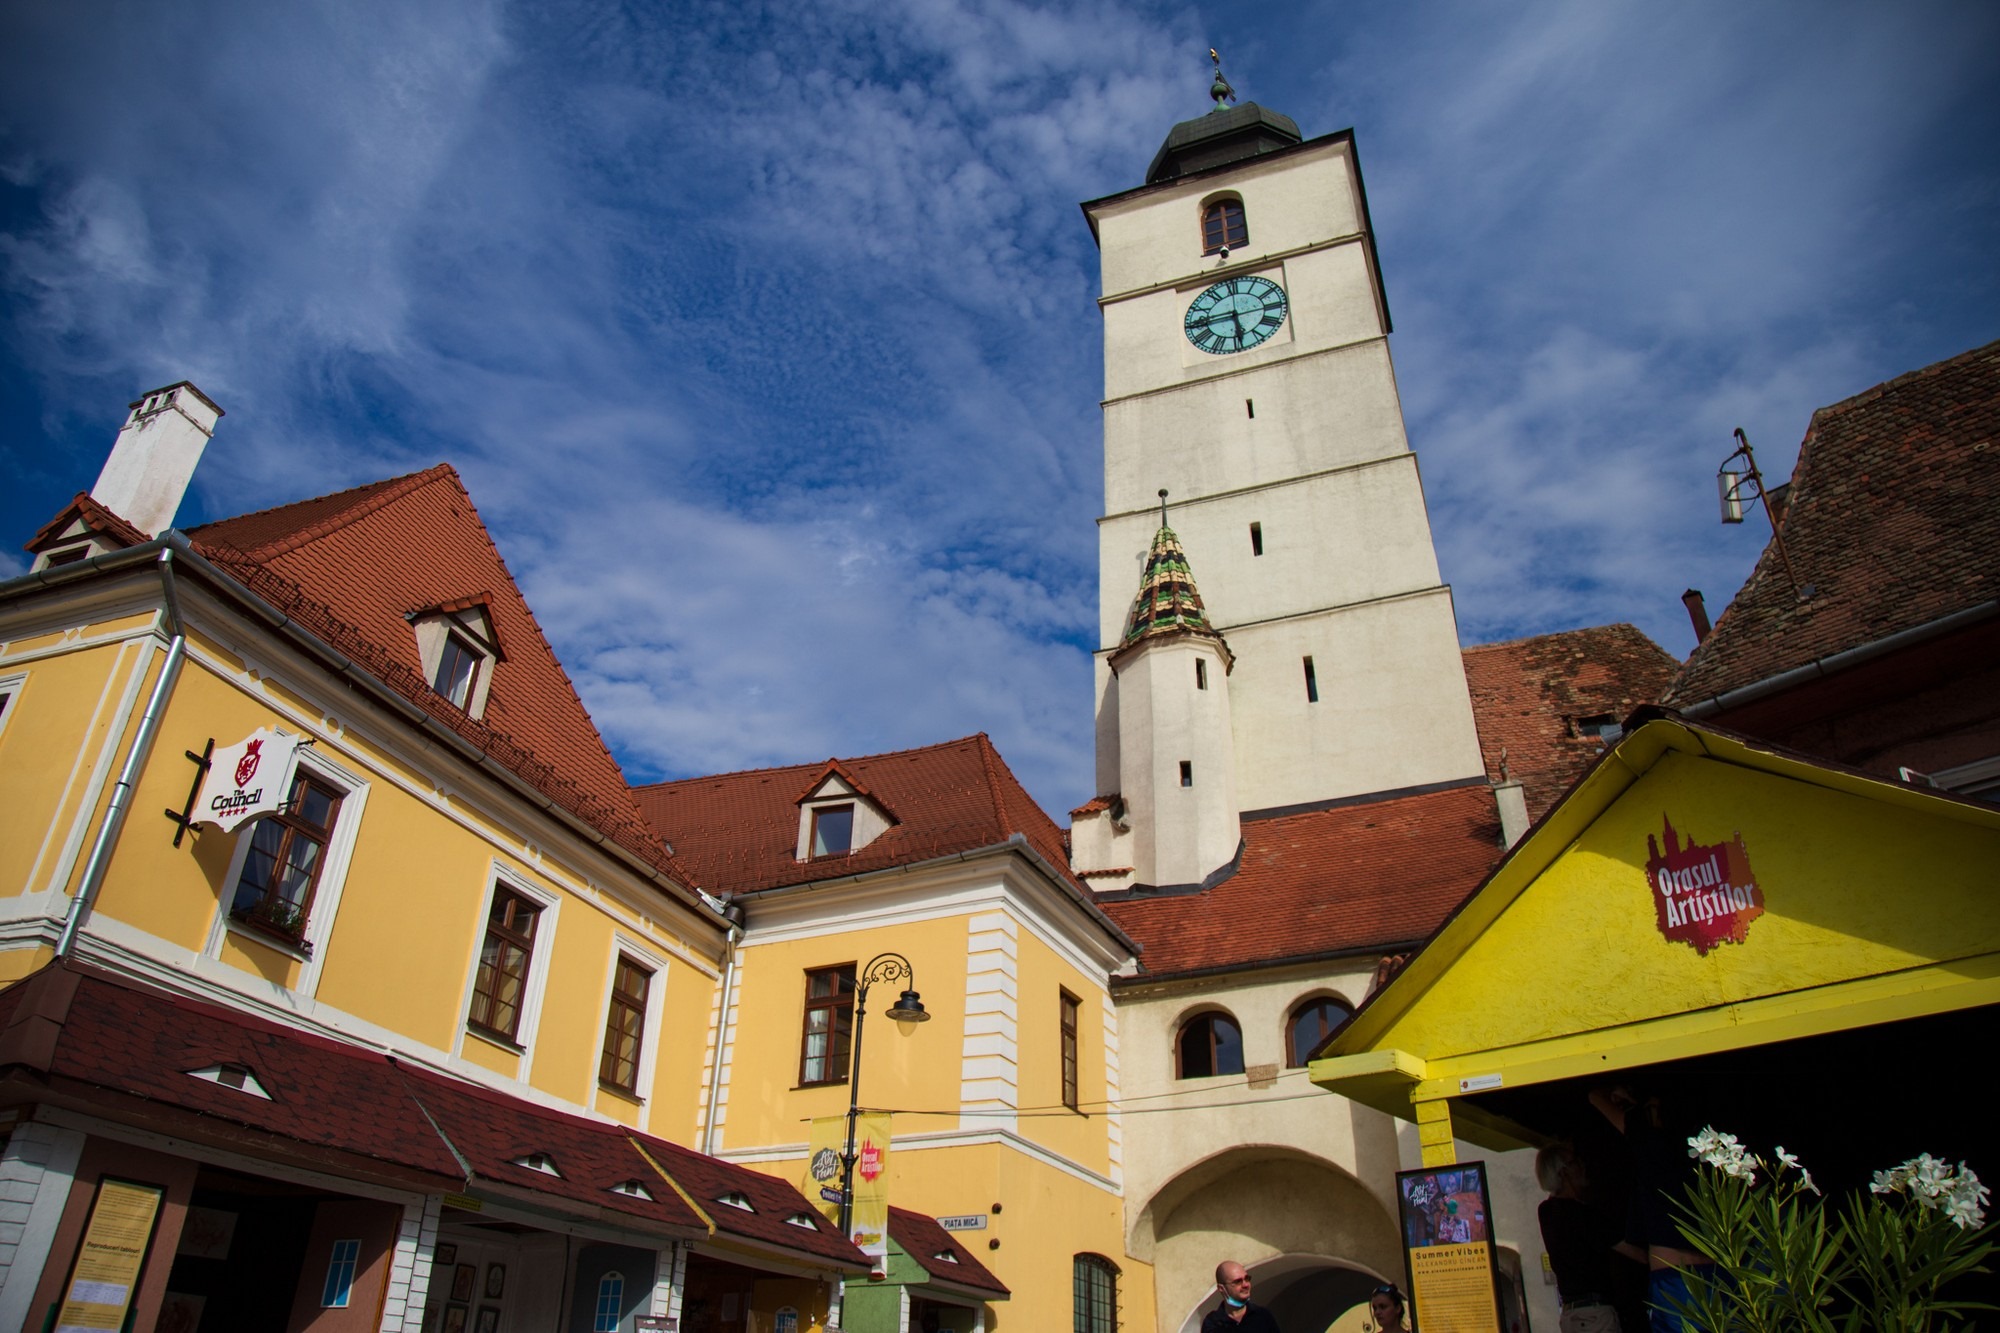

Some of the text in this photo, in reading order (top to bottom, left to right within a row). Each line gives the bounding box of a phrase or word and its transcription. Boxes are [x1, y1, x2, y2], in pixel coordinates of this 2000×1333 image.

[211, 789, 263, 810] Council
[964, 1216, 979, 1227] MICĂ
[1415, 1247, 1485, 1260] Summer Vibes
